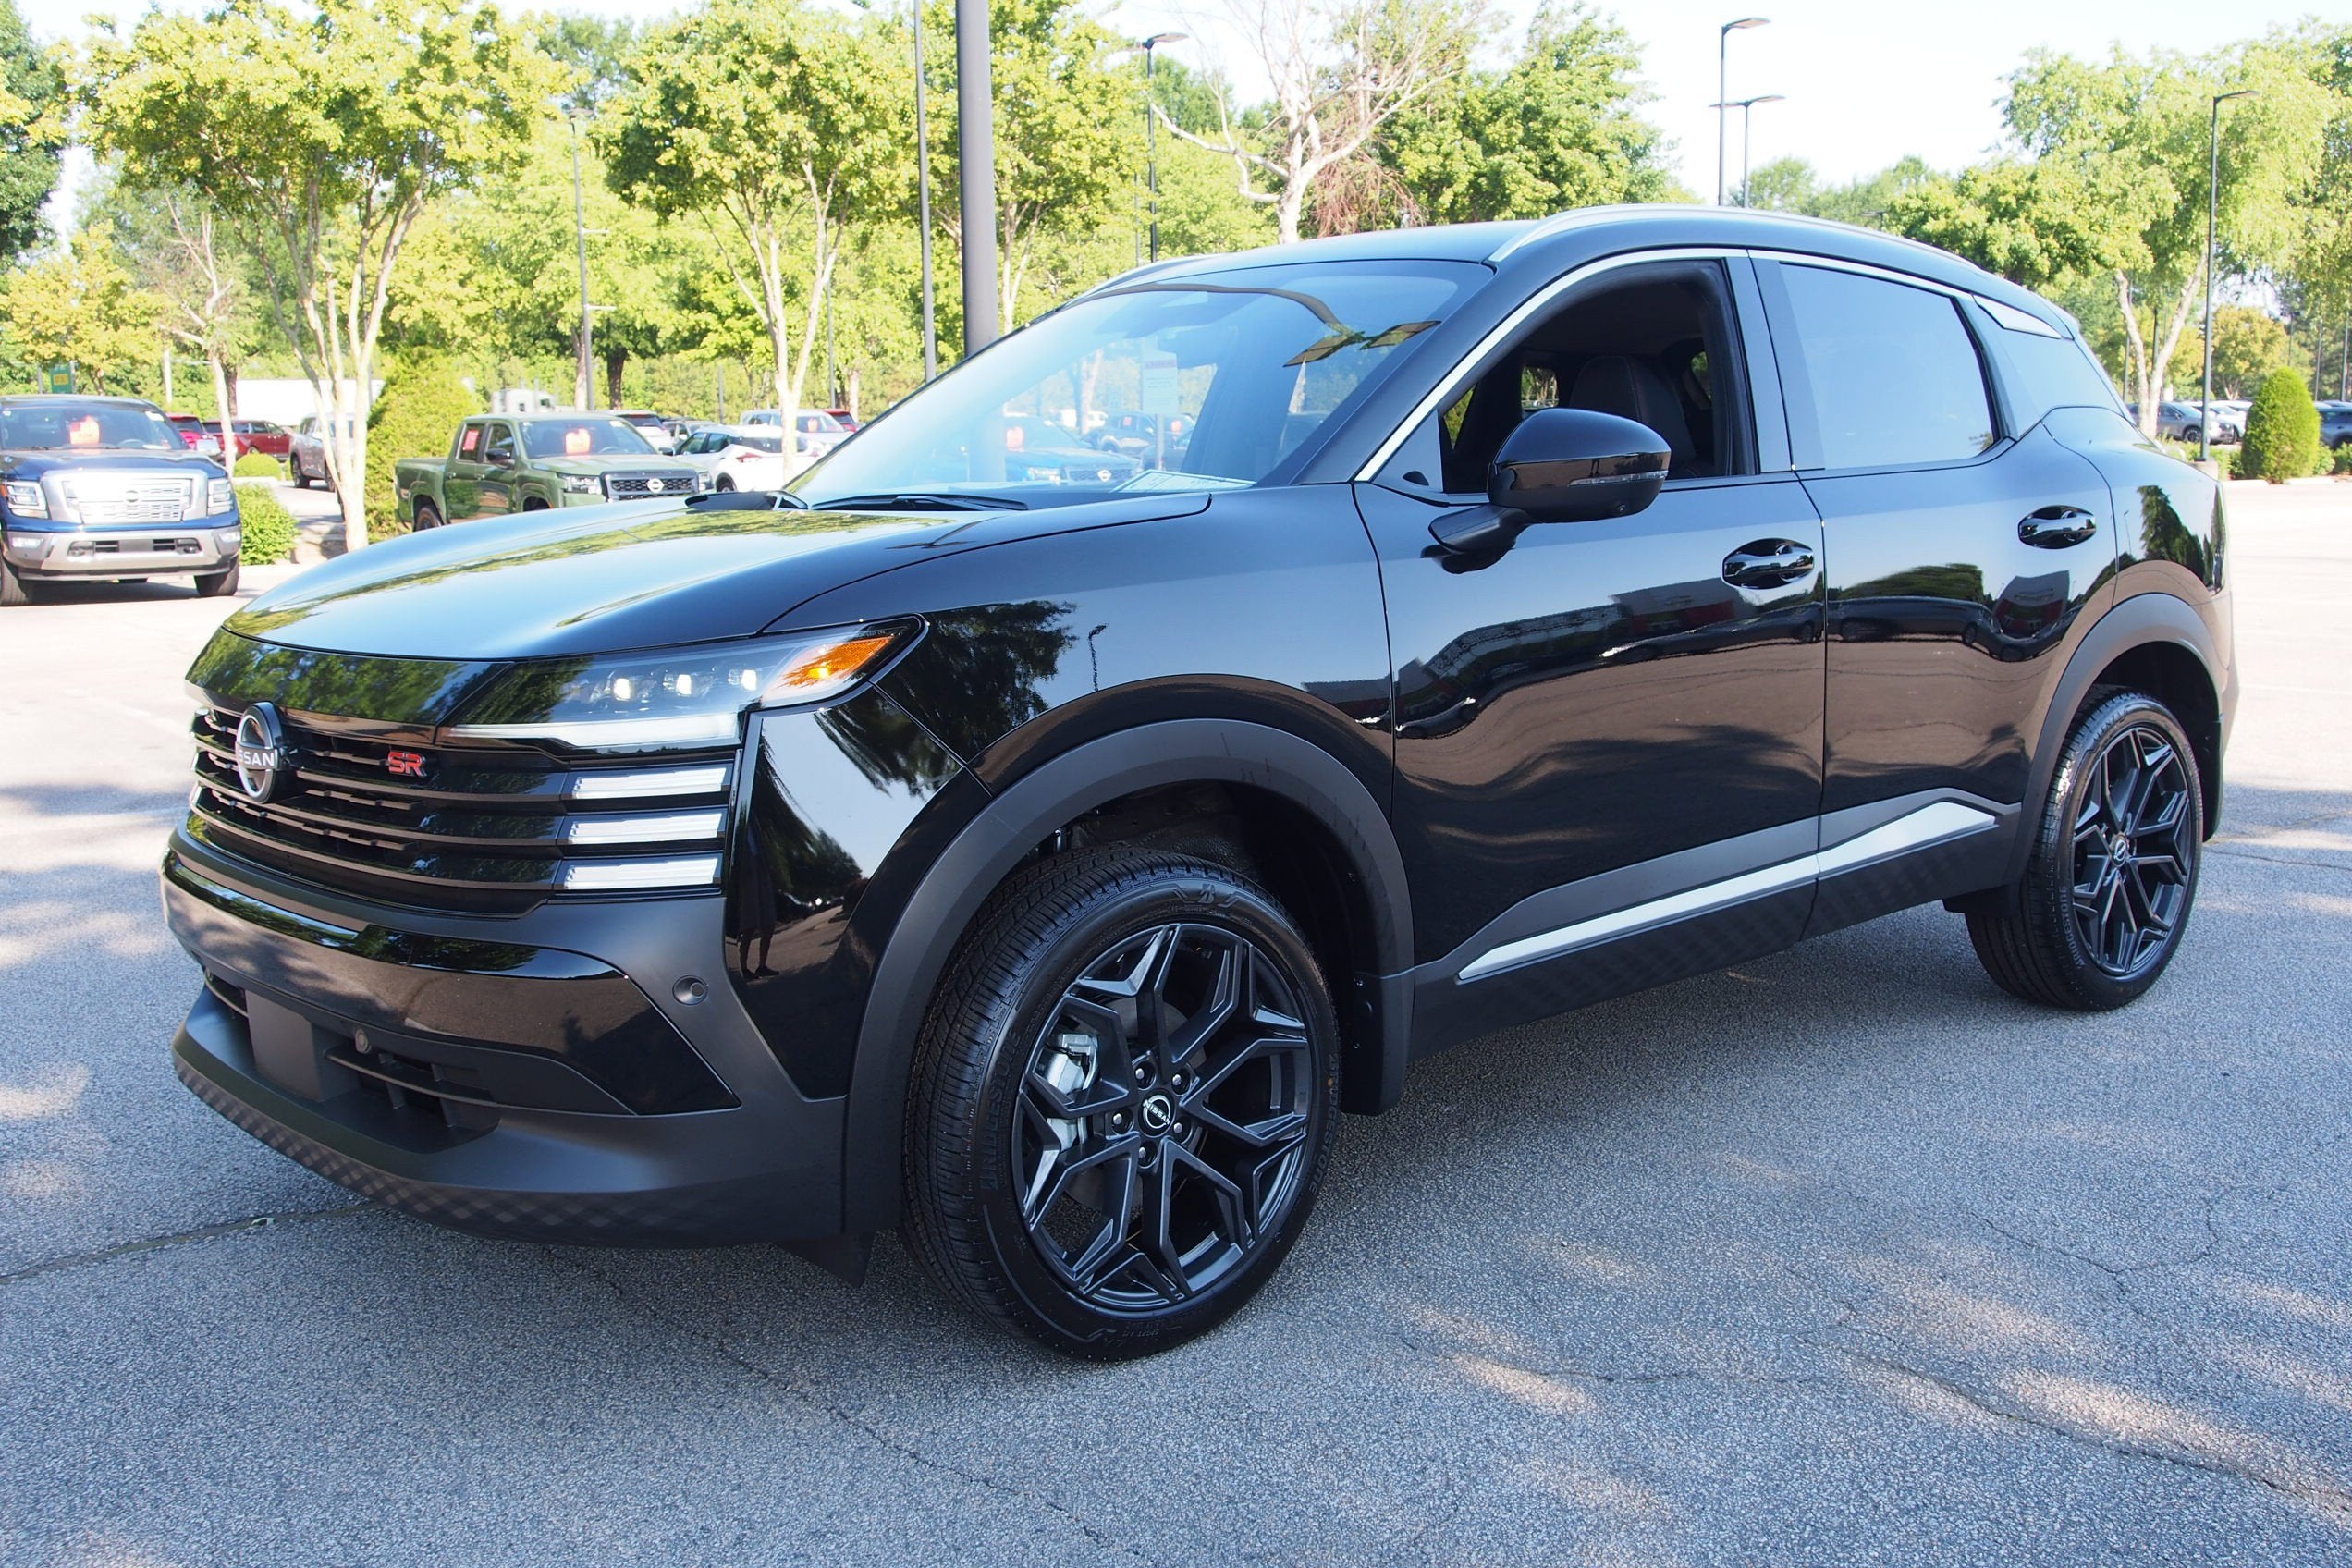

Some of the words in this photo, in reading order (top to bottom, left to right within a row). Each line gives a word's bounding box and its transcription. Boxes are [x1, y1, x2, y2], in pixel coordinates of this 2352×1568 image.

[238, 749, 275, 767] SSAN
[388, 751, 425, 777] SR
[2059, 885, 2086, 970] BRIDGESTONE
[978, 1026, 1022, 1192] BRIDGESTONE
[1143, 1099, 1171, 1125] NISSAN
